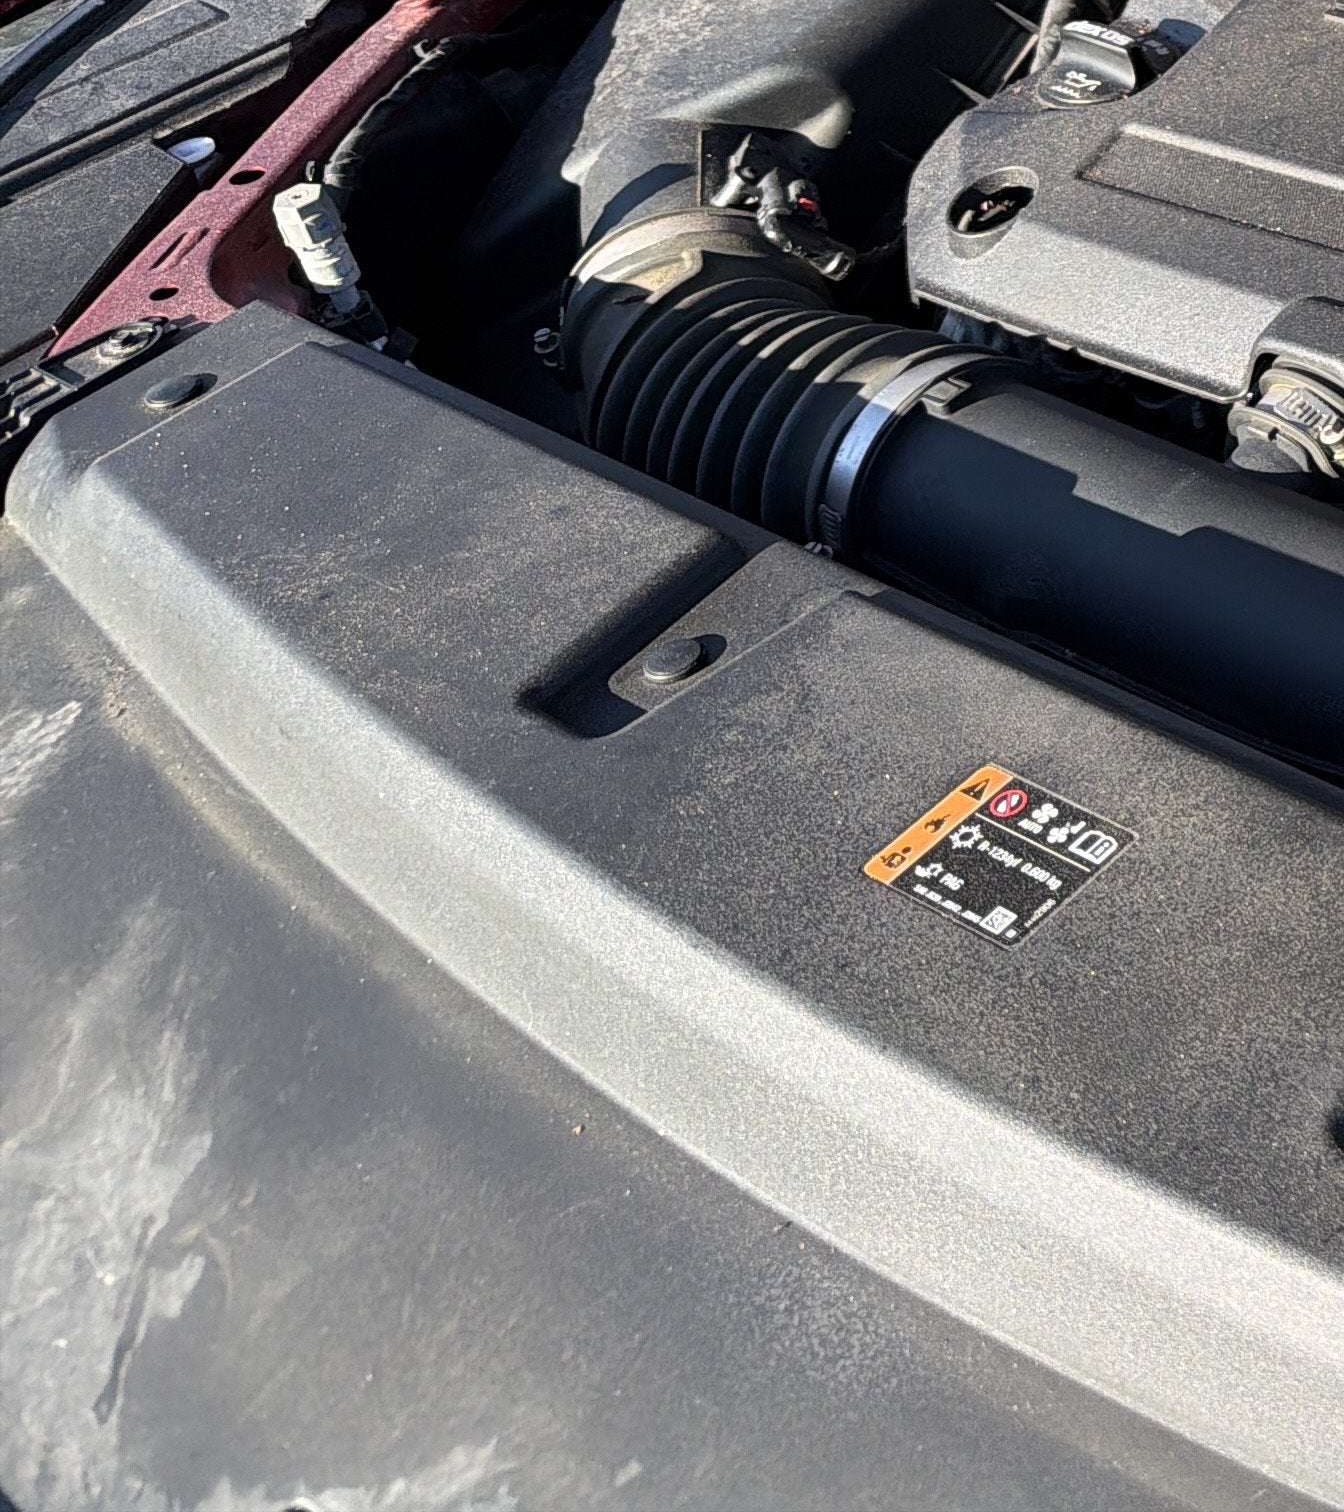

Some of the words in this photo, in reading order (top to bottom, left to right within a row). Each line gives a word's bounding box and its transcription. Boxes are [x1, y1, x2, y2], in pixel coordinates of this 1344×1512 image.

[1017, 818, 1044, 834] AUTO
[976, 839, 1024, 868] R-1234yf
[1020, 862, 1051, 883] 0.600
[1045, 874, 1063, 891] kg
[938, 872, 965, 891] PAG
